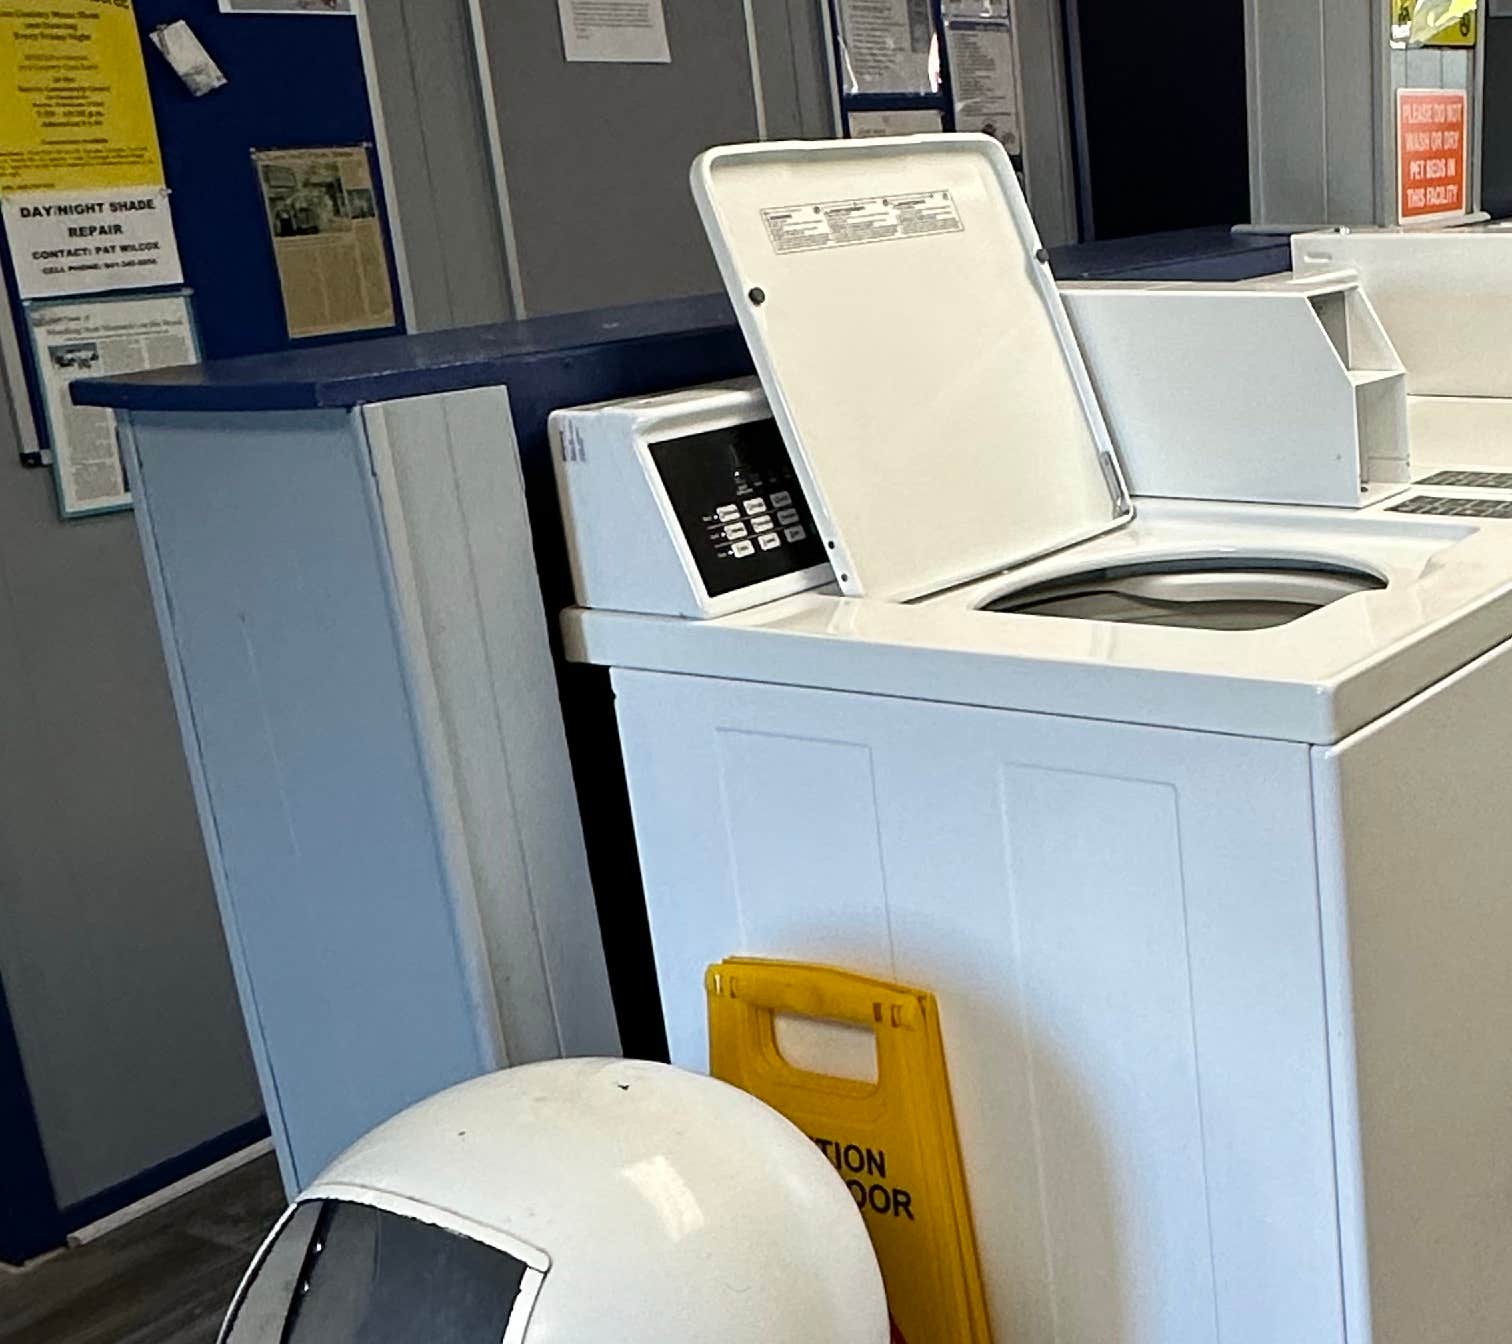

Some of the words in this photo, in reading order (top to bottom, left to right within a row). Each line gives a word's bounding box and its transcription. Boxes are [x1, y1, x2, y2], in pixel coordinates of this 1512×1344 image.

[1402, 103, 1432, 124] PLEASE
[1433, 103, 1445, 123] DO
[1446, 103, 1462, 122] NOT
[1405, 132, 1429, 152] WASH
[1430, 131, 1442, 151] OR
[1444, 130, 1460, 149] DRY
[1410, 160, 1425, 180] PET
[1447, 158, 1456, 176] IN
[109, 199, 155, 213] SHADE
[1407, 188, 1425, 208] THIS
[1426, 184, 1458, 206] FACILITY
[68, 224, 123, 238] REPAIR
[32, 247, 91, 260] CONTACT:
[95, 246, 116, 255] PAT
[119, 241, 160, 252] WILCOX
[42, 266, 65, 274] CELL
[811, 1136, 886, 1178] TION
[846, 1179, 915, 1221] OOR
